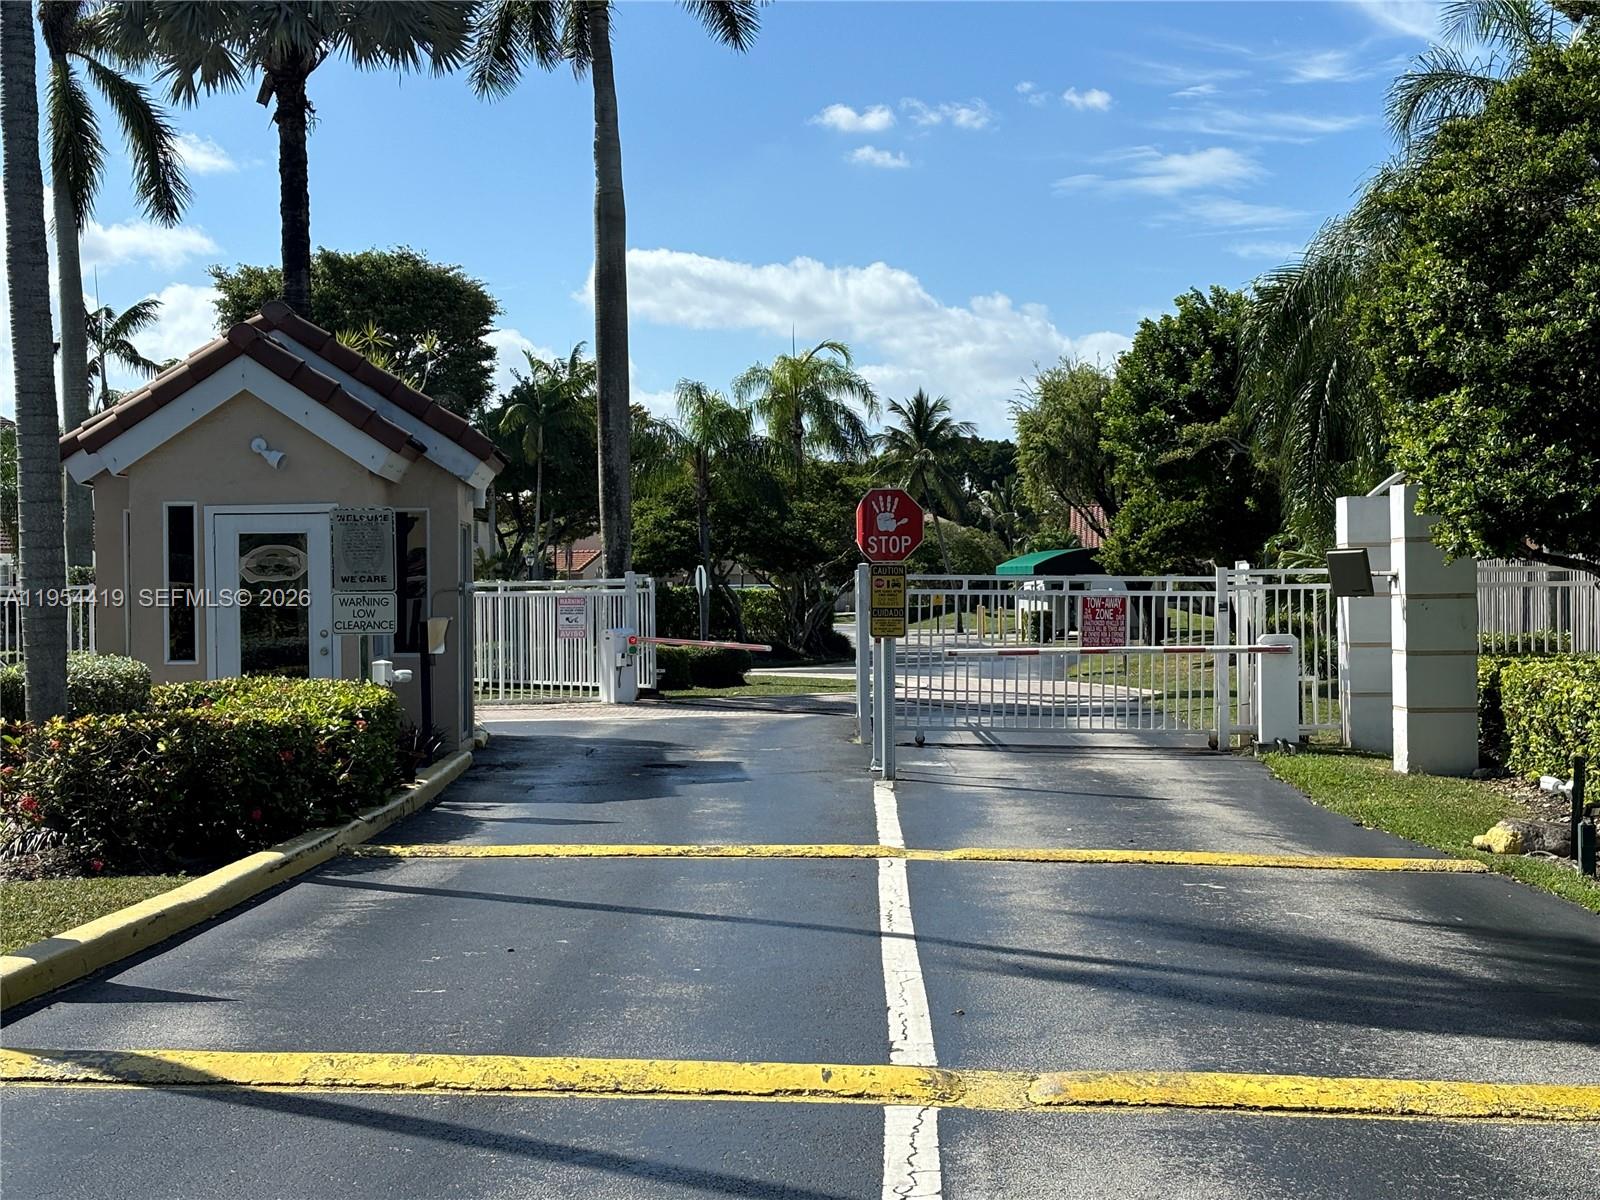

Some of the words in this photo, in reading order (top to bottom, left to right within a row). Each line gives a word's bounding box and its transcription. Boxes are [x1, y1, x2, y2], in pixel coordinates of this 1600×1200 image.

[867, 535, 912, 554] STOP
[872, 566, 904, 575] CAUTION
[341, 575, 357, 583] WE
[358, 575, 388, 583] CARE
[339, 597, 390, 607] WARNING
[1086, 597, 1122, 608] TOW-AWAY
[352, 609, 376, 619] LOW
[872, 608, 904, 617] CUIDADO
[1095, 608, 1114, 620] ZONE
[334, 620, 395, 630] CLEARANCE
